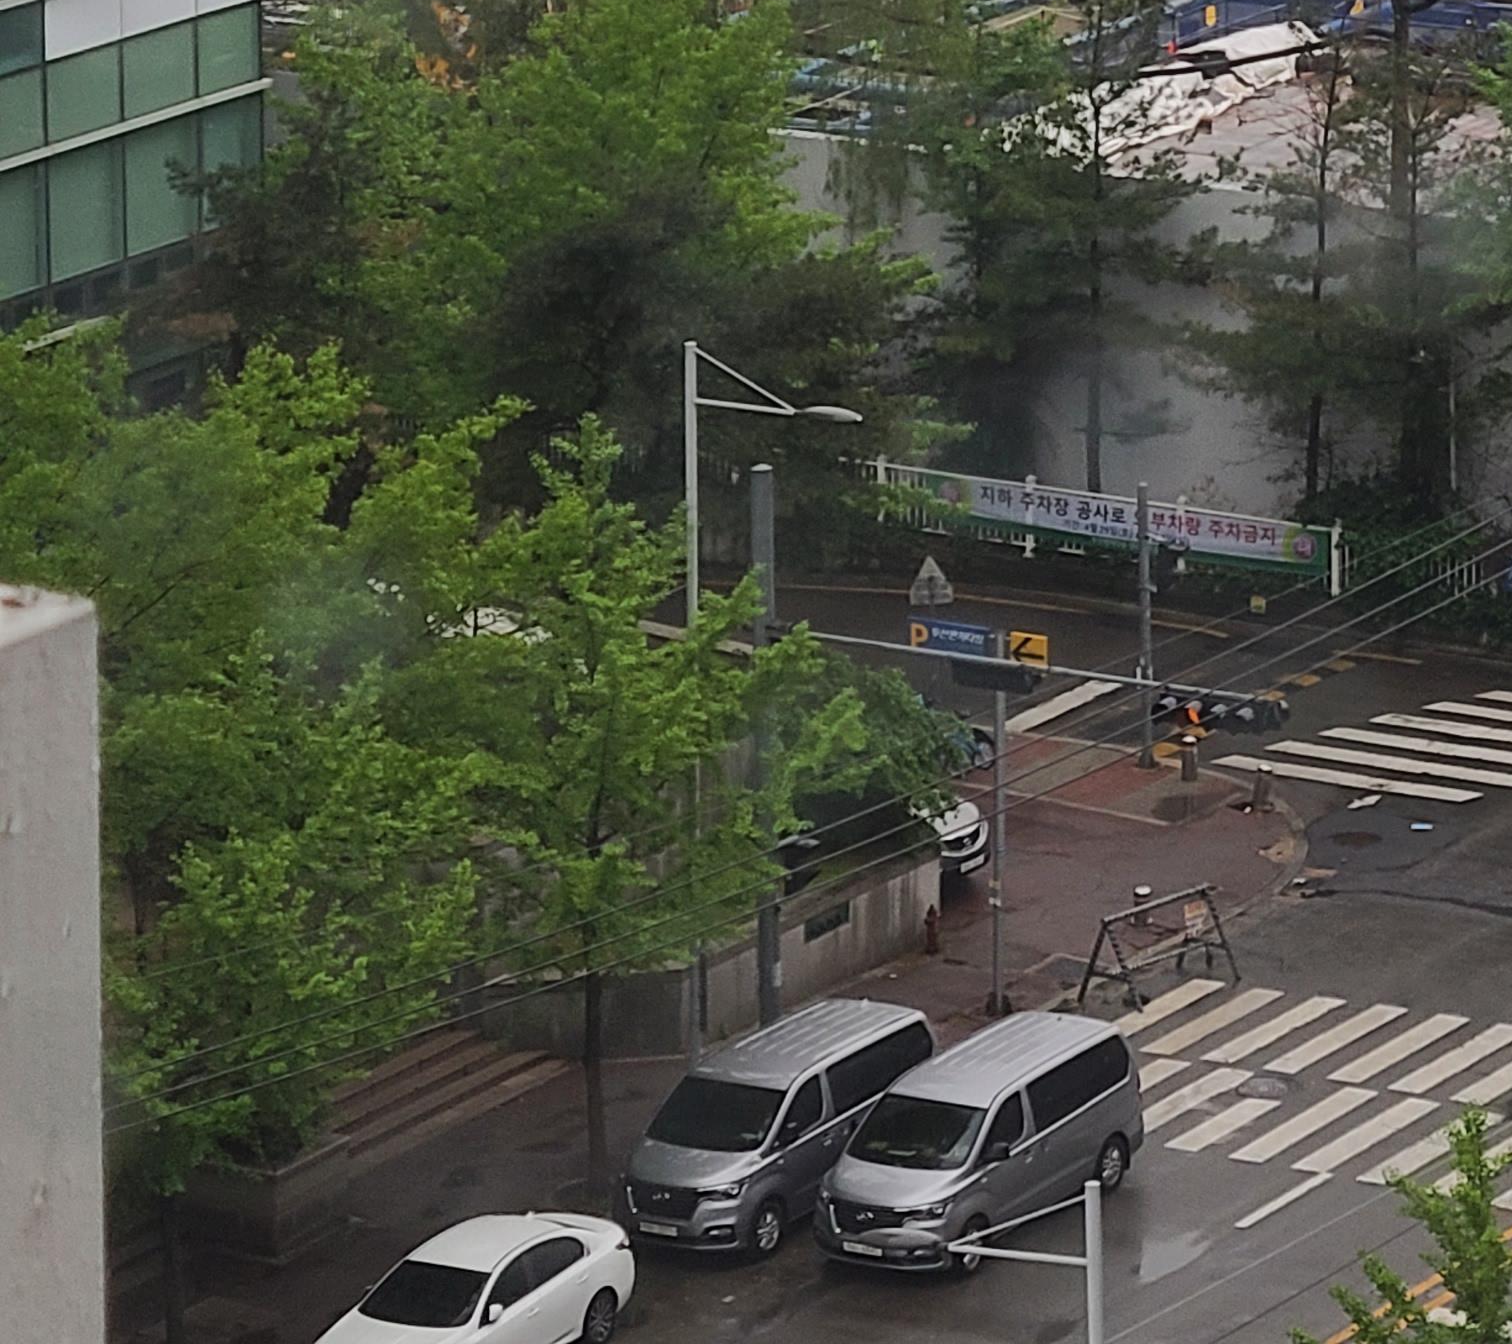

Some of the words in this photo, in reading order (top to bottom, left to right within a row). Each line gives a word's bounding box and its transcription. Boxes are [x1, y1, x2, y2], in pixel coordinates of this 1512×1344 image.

[981, 485, 1013, 509] 지하
[1020, 492, 1070, 517] 주차장
[1076, 500, 1127, 524] 공사로
[1134, 511, 1202, 537] 부차량
[1208, 519, 1277, 546] 주차금지
[911, 623, 928, 647] P
